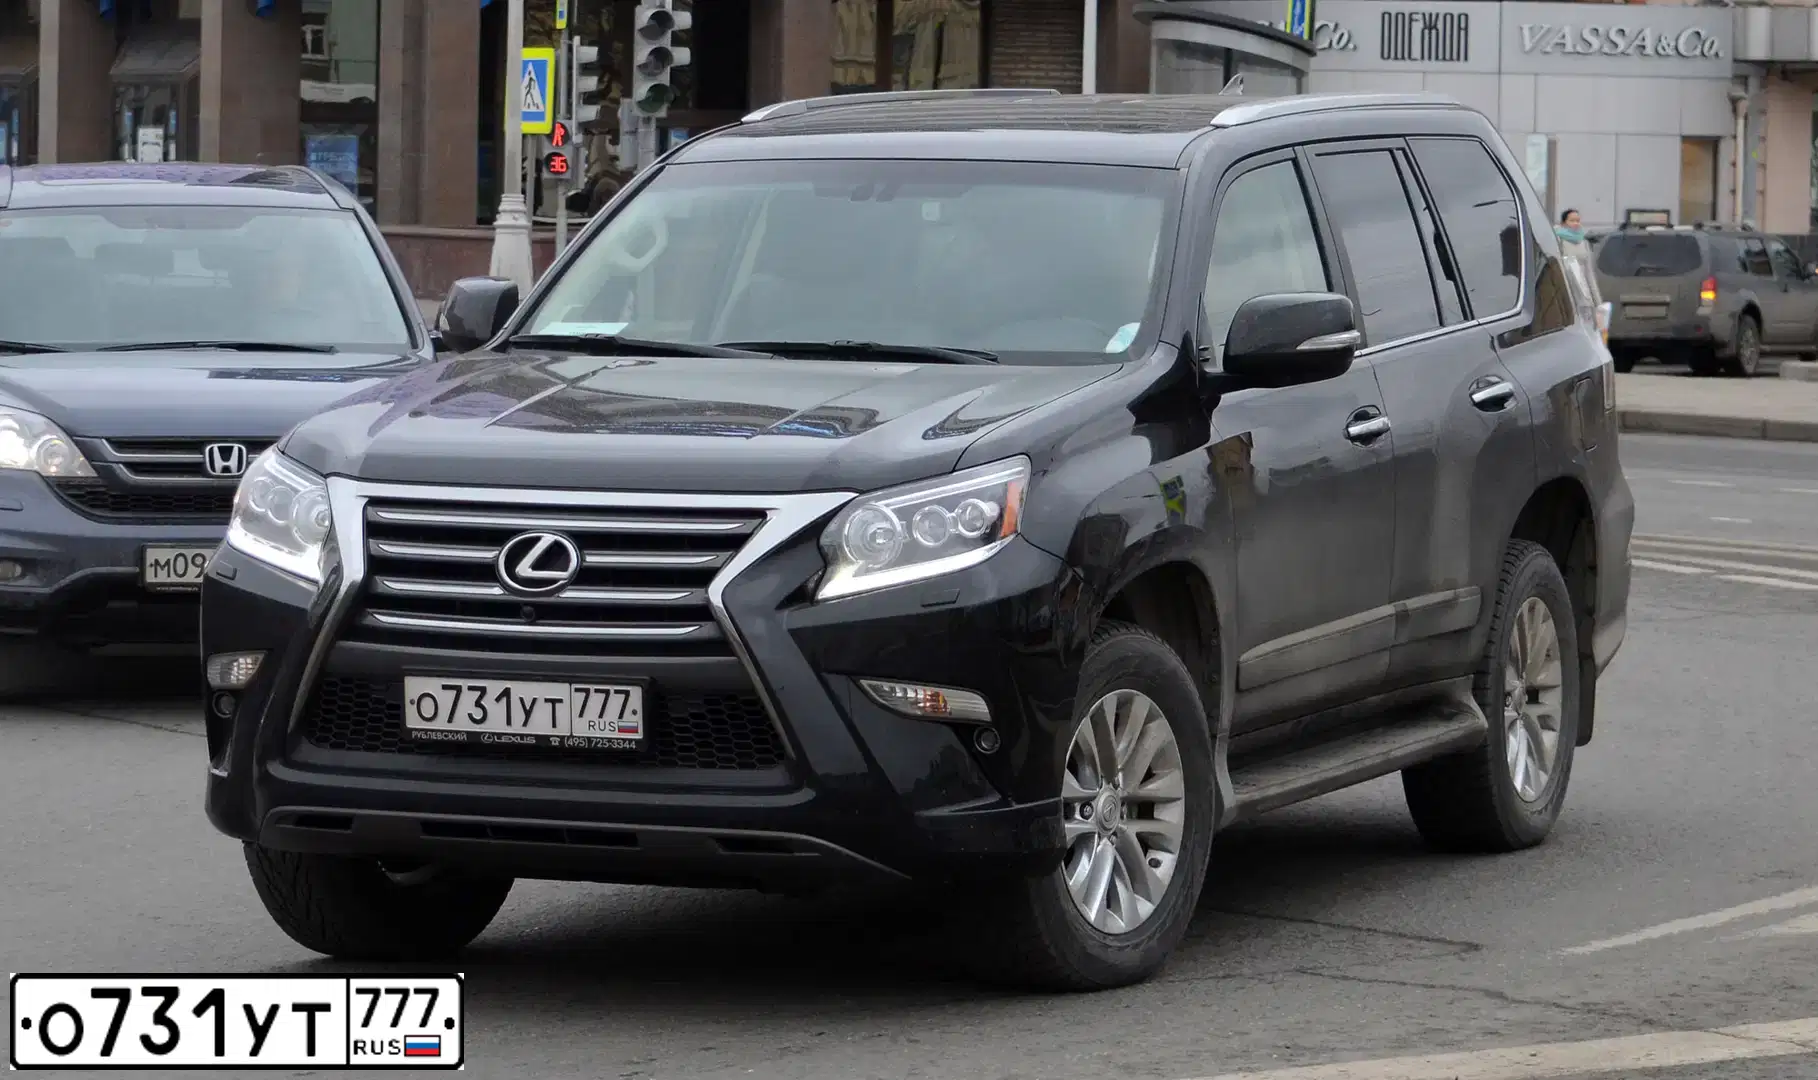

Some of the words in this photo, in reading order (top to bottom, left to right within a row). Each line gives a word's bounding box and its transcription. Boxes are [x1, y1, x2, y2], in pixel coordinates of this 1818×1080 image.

[1380, 11, 1469, 62] ОДЕЖДА
[1519, 23, 1725, 59] VASSA&Co.
[574, 687, 631, 720] 777
[588, 720, 616, 732] RUS
[411, 730, 467, 741] РУБЛЕВСКИЙ
[494, 735, 536, 744] LEXUS
[564, 736, 588, 748] (495)
